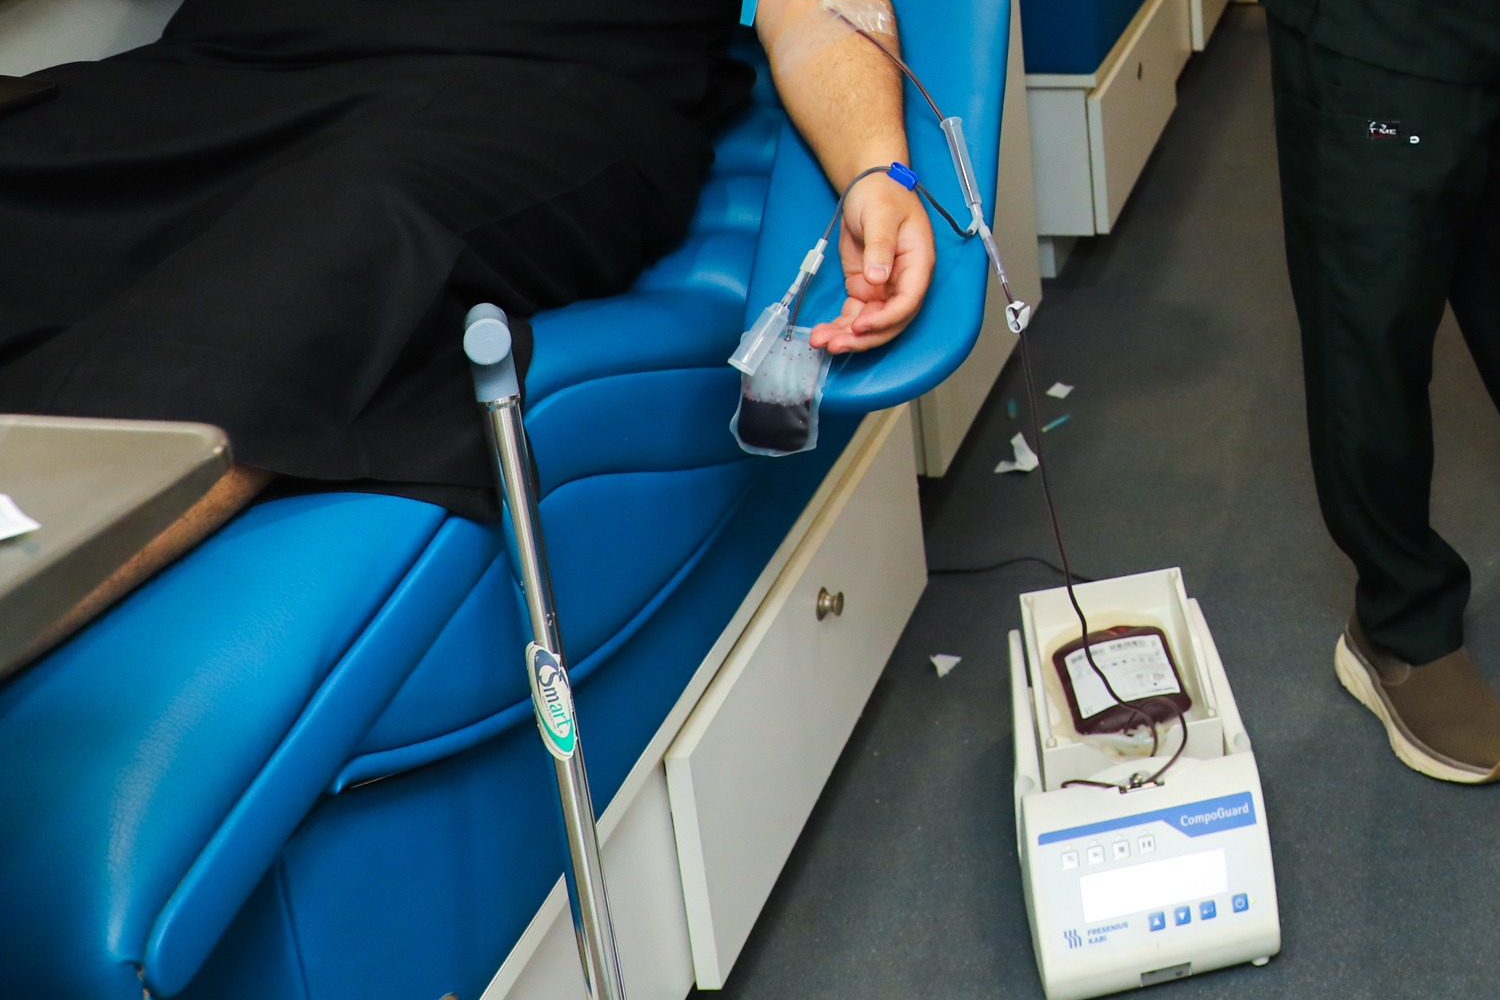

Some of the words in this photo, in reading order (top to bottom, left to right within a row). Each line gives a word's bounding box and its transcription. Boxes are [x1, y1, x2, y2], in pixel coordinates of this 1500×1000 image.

[1369, 127, 1397, 135] TME
[539, 670, 572, 728] Smart
[1180, 802, 1249, 827] CompoGuard
[1087, 921, 1128, 936] FRESENIUS
[1088, 935, 1107, 945] KABI
